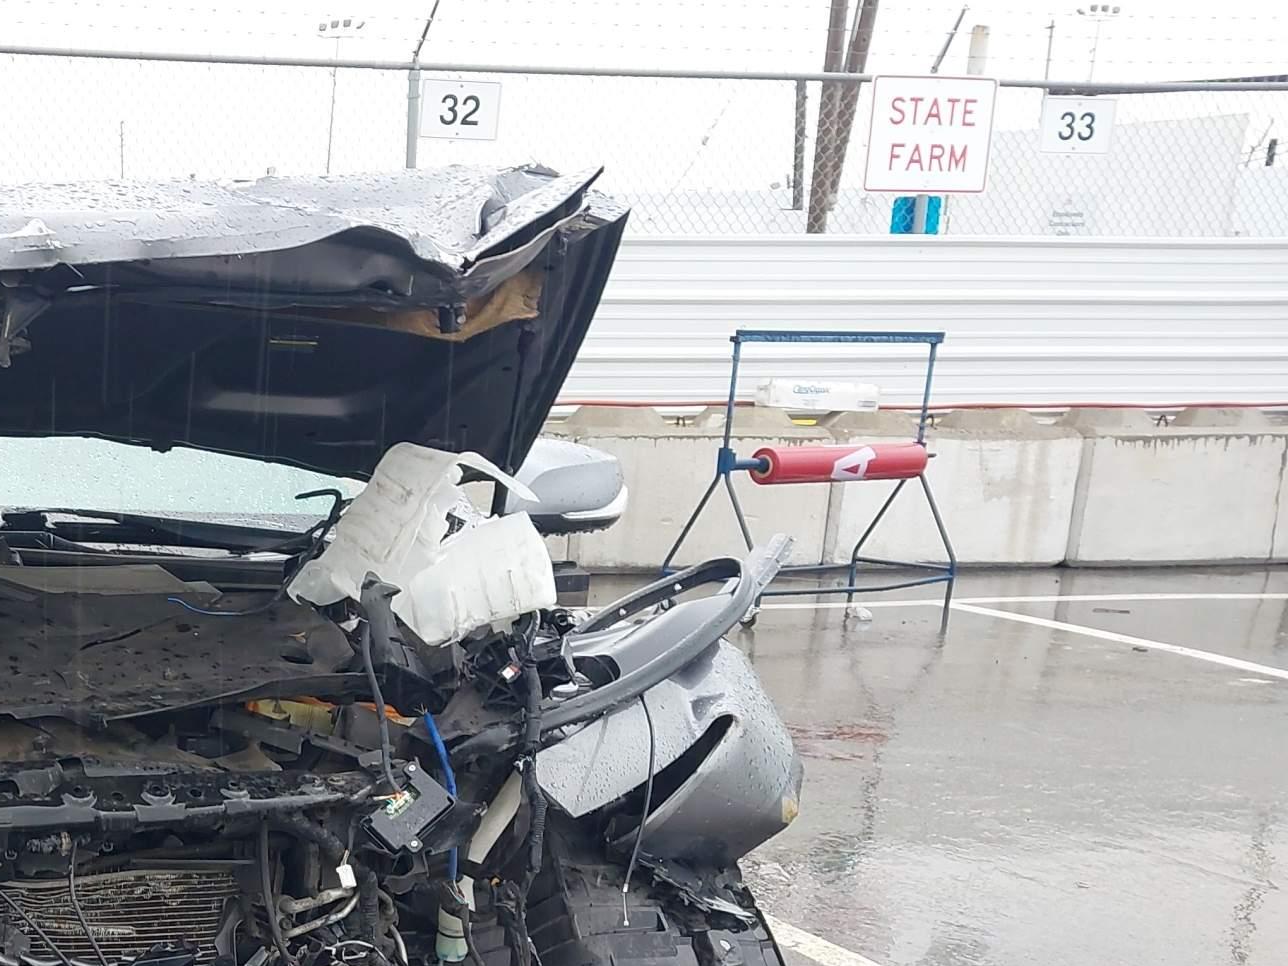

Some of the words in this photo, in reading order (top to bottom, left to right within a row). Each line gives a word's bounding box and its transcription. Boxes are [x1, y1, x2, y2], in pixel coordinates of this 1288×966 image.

[439, 94, 481, 126] 32
[889, 97, 978, 127] STATE
[1057, 111, 1096, 142] 33
[887, 143, 968, 173] FARM
